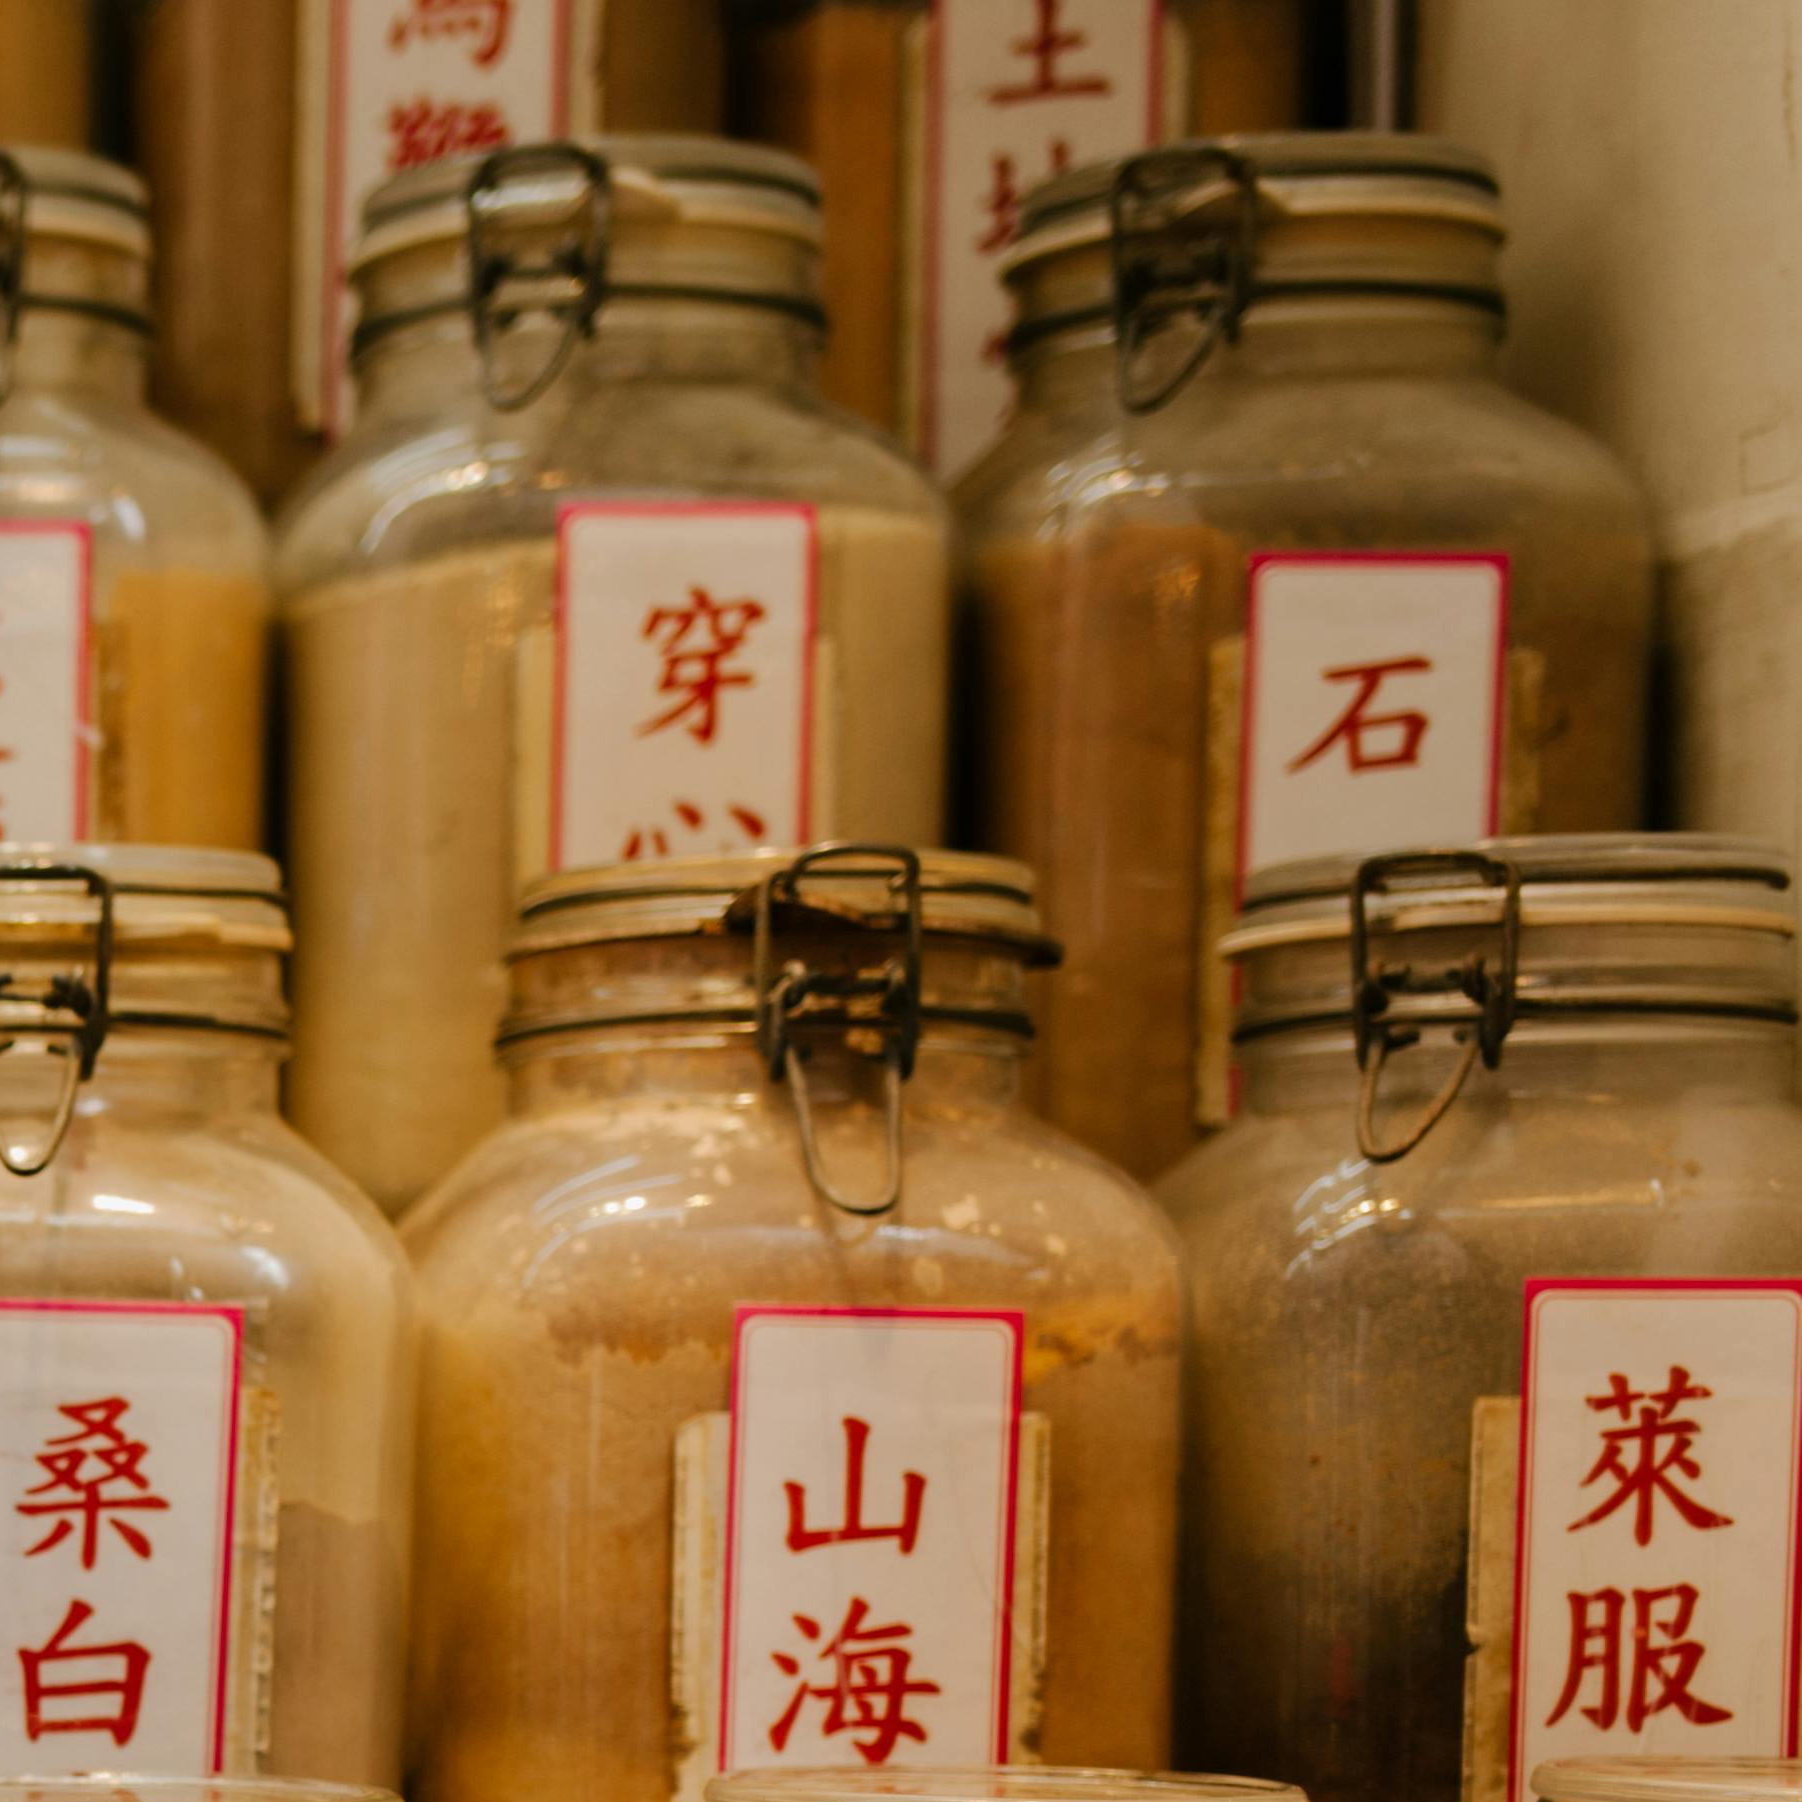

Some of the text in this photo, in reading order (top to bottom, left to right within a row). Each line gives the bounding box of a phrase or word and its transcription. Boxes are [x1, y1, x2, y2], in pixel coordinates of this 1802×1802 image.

[1286, 657, 1432, 775] 石
[16, 1396, 169, 1746] 桑白
[769, 1416, 941, 1768] 山海
[1545, 1365, 1733, 1734] 萊服
